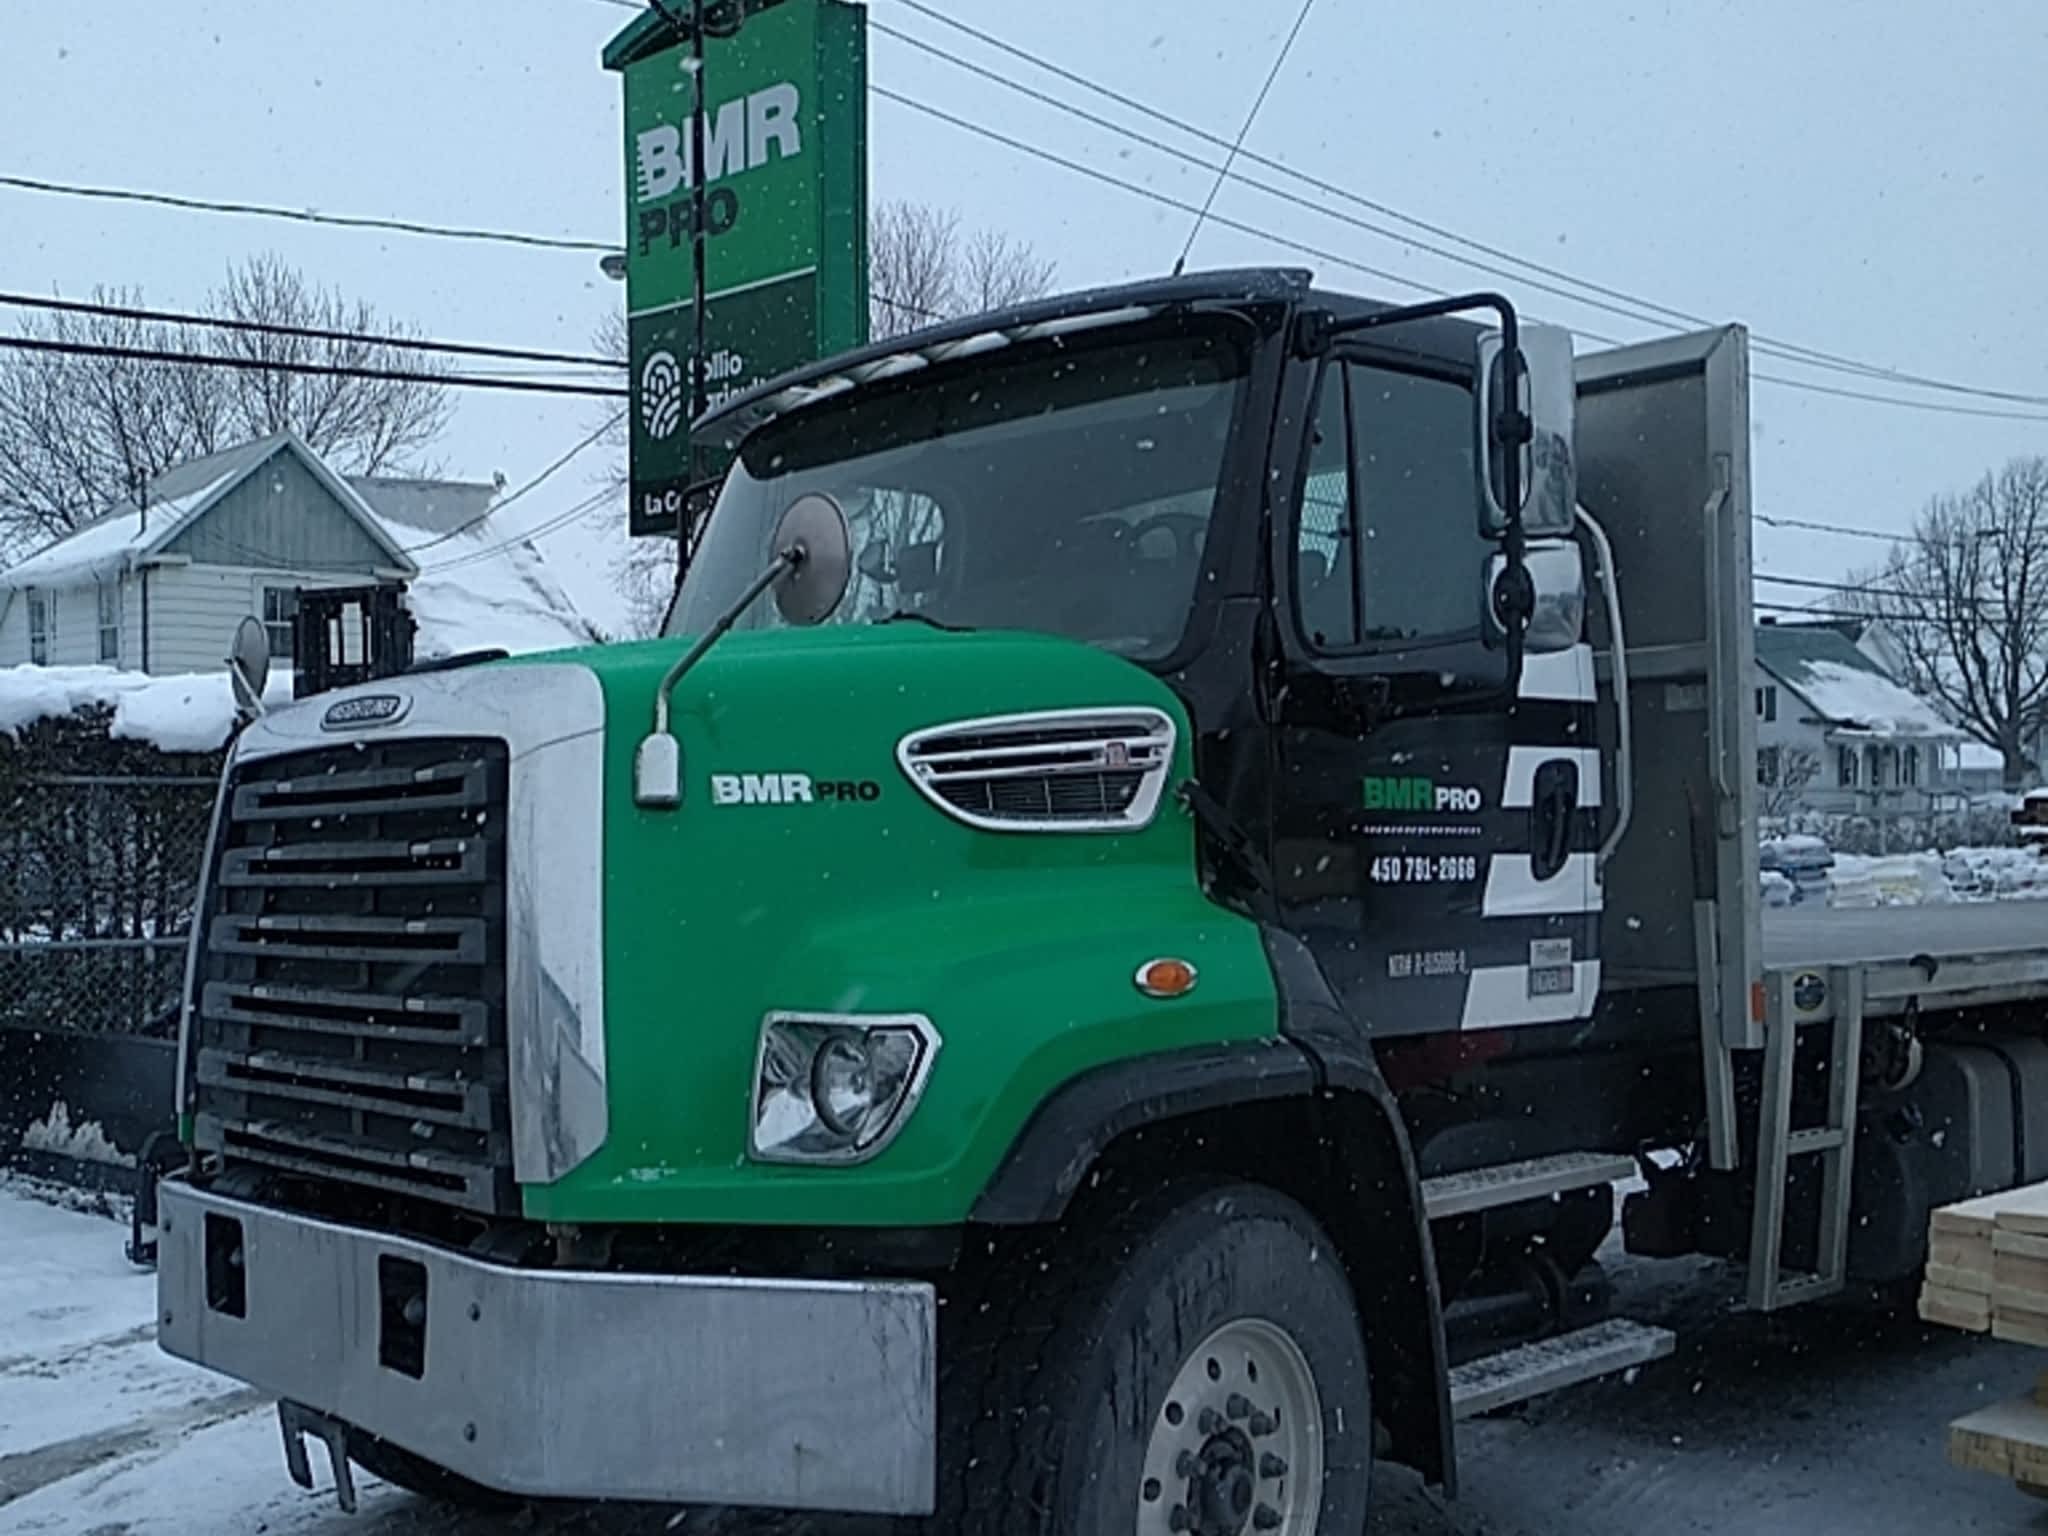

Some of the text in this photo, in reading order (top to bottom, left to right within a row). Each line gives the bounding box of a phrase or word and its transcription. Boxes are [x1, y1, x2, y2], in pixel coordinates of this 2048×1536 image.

[637, 82, 800, 203] BMR
[639, 187, 739, 256] PRO
[711, 774, 881, 805] BMR PRO
[1363, 776, 1481, 811] BMR PRO
[1370, 856, 1401, 882] 450
